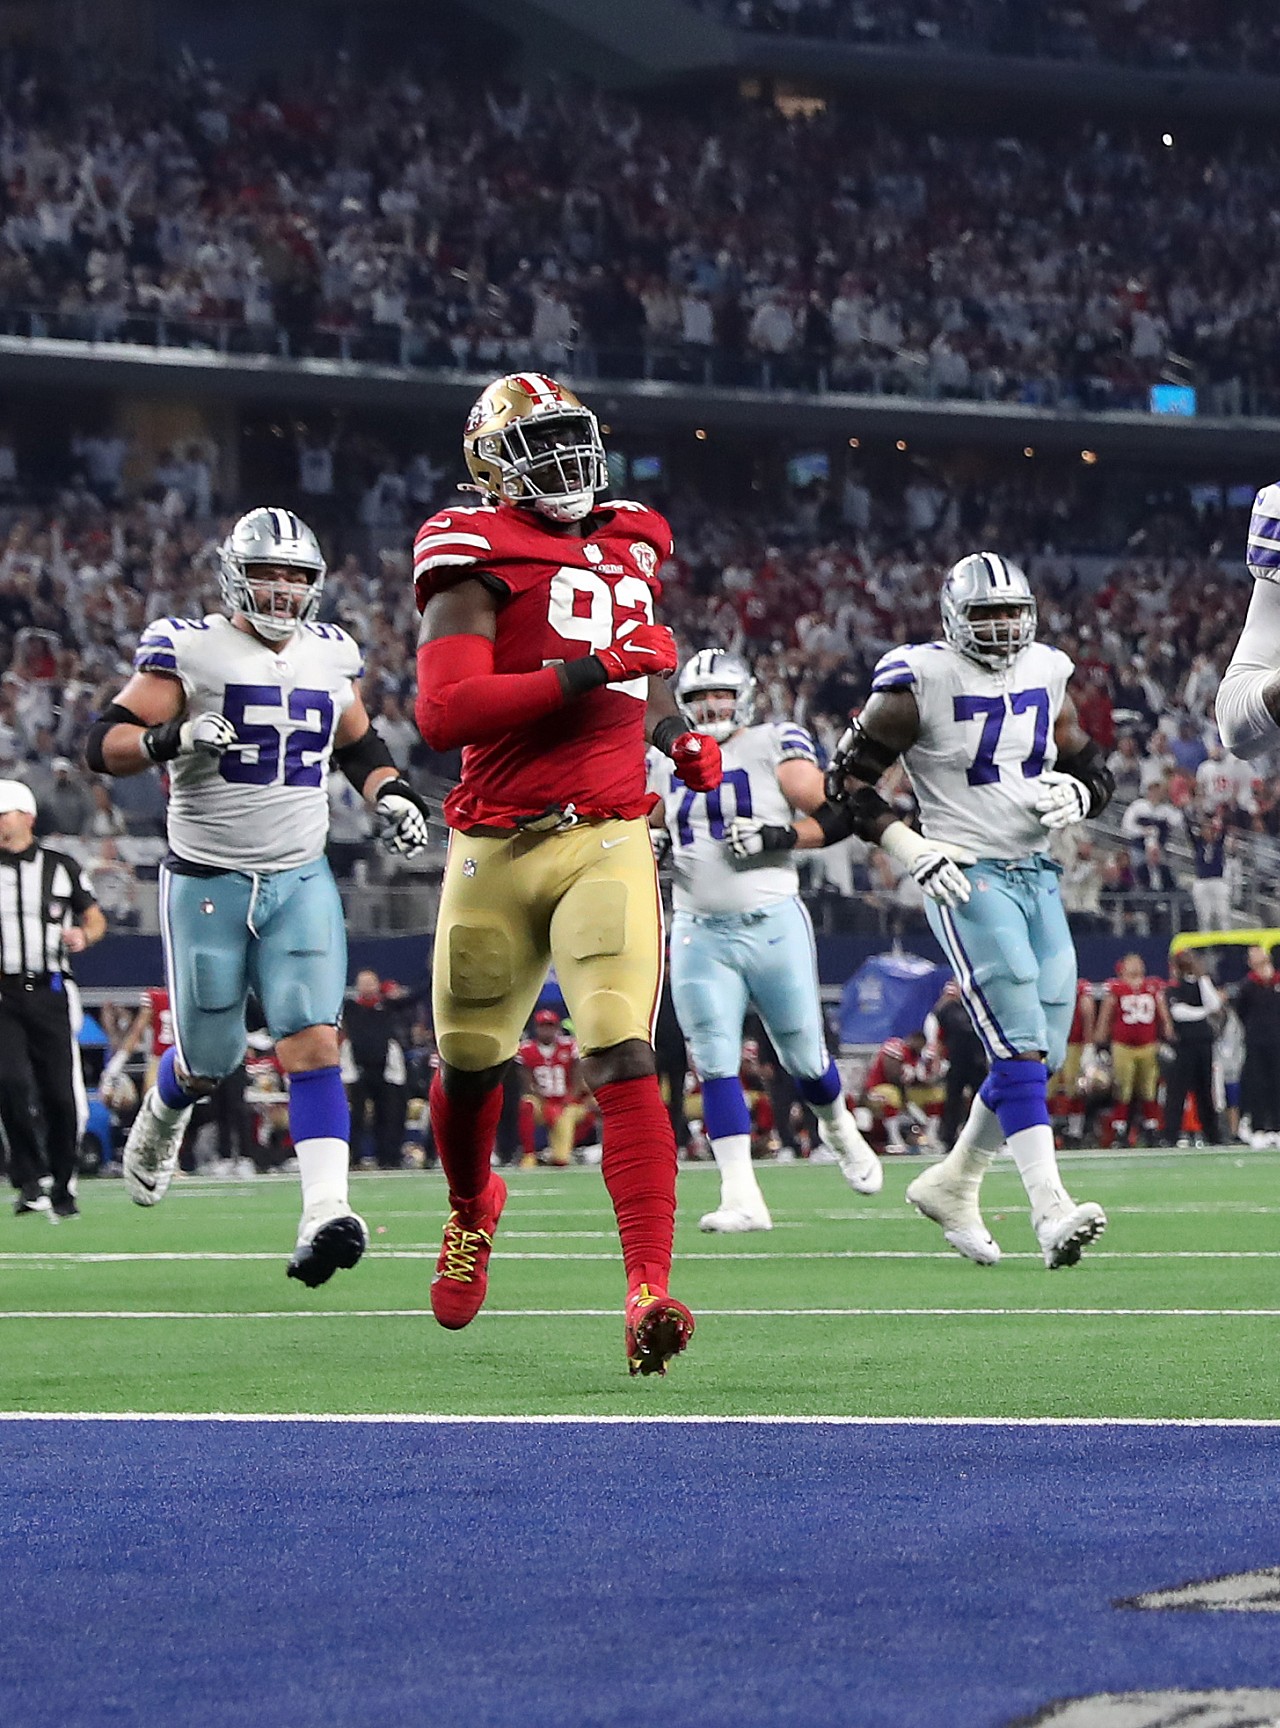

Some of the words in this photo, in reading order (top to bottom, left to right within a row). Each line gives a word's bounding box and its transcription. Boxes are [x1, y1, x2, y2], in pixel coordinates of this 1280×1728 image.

[218, 683, 335, 788] 52
[952, 687, 1050, 787] 77
[669, 768, 753, 846] 70
